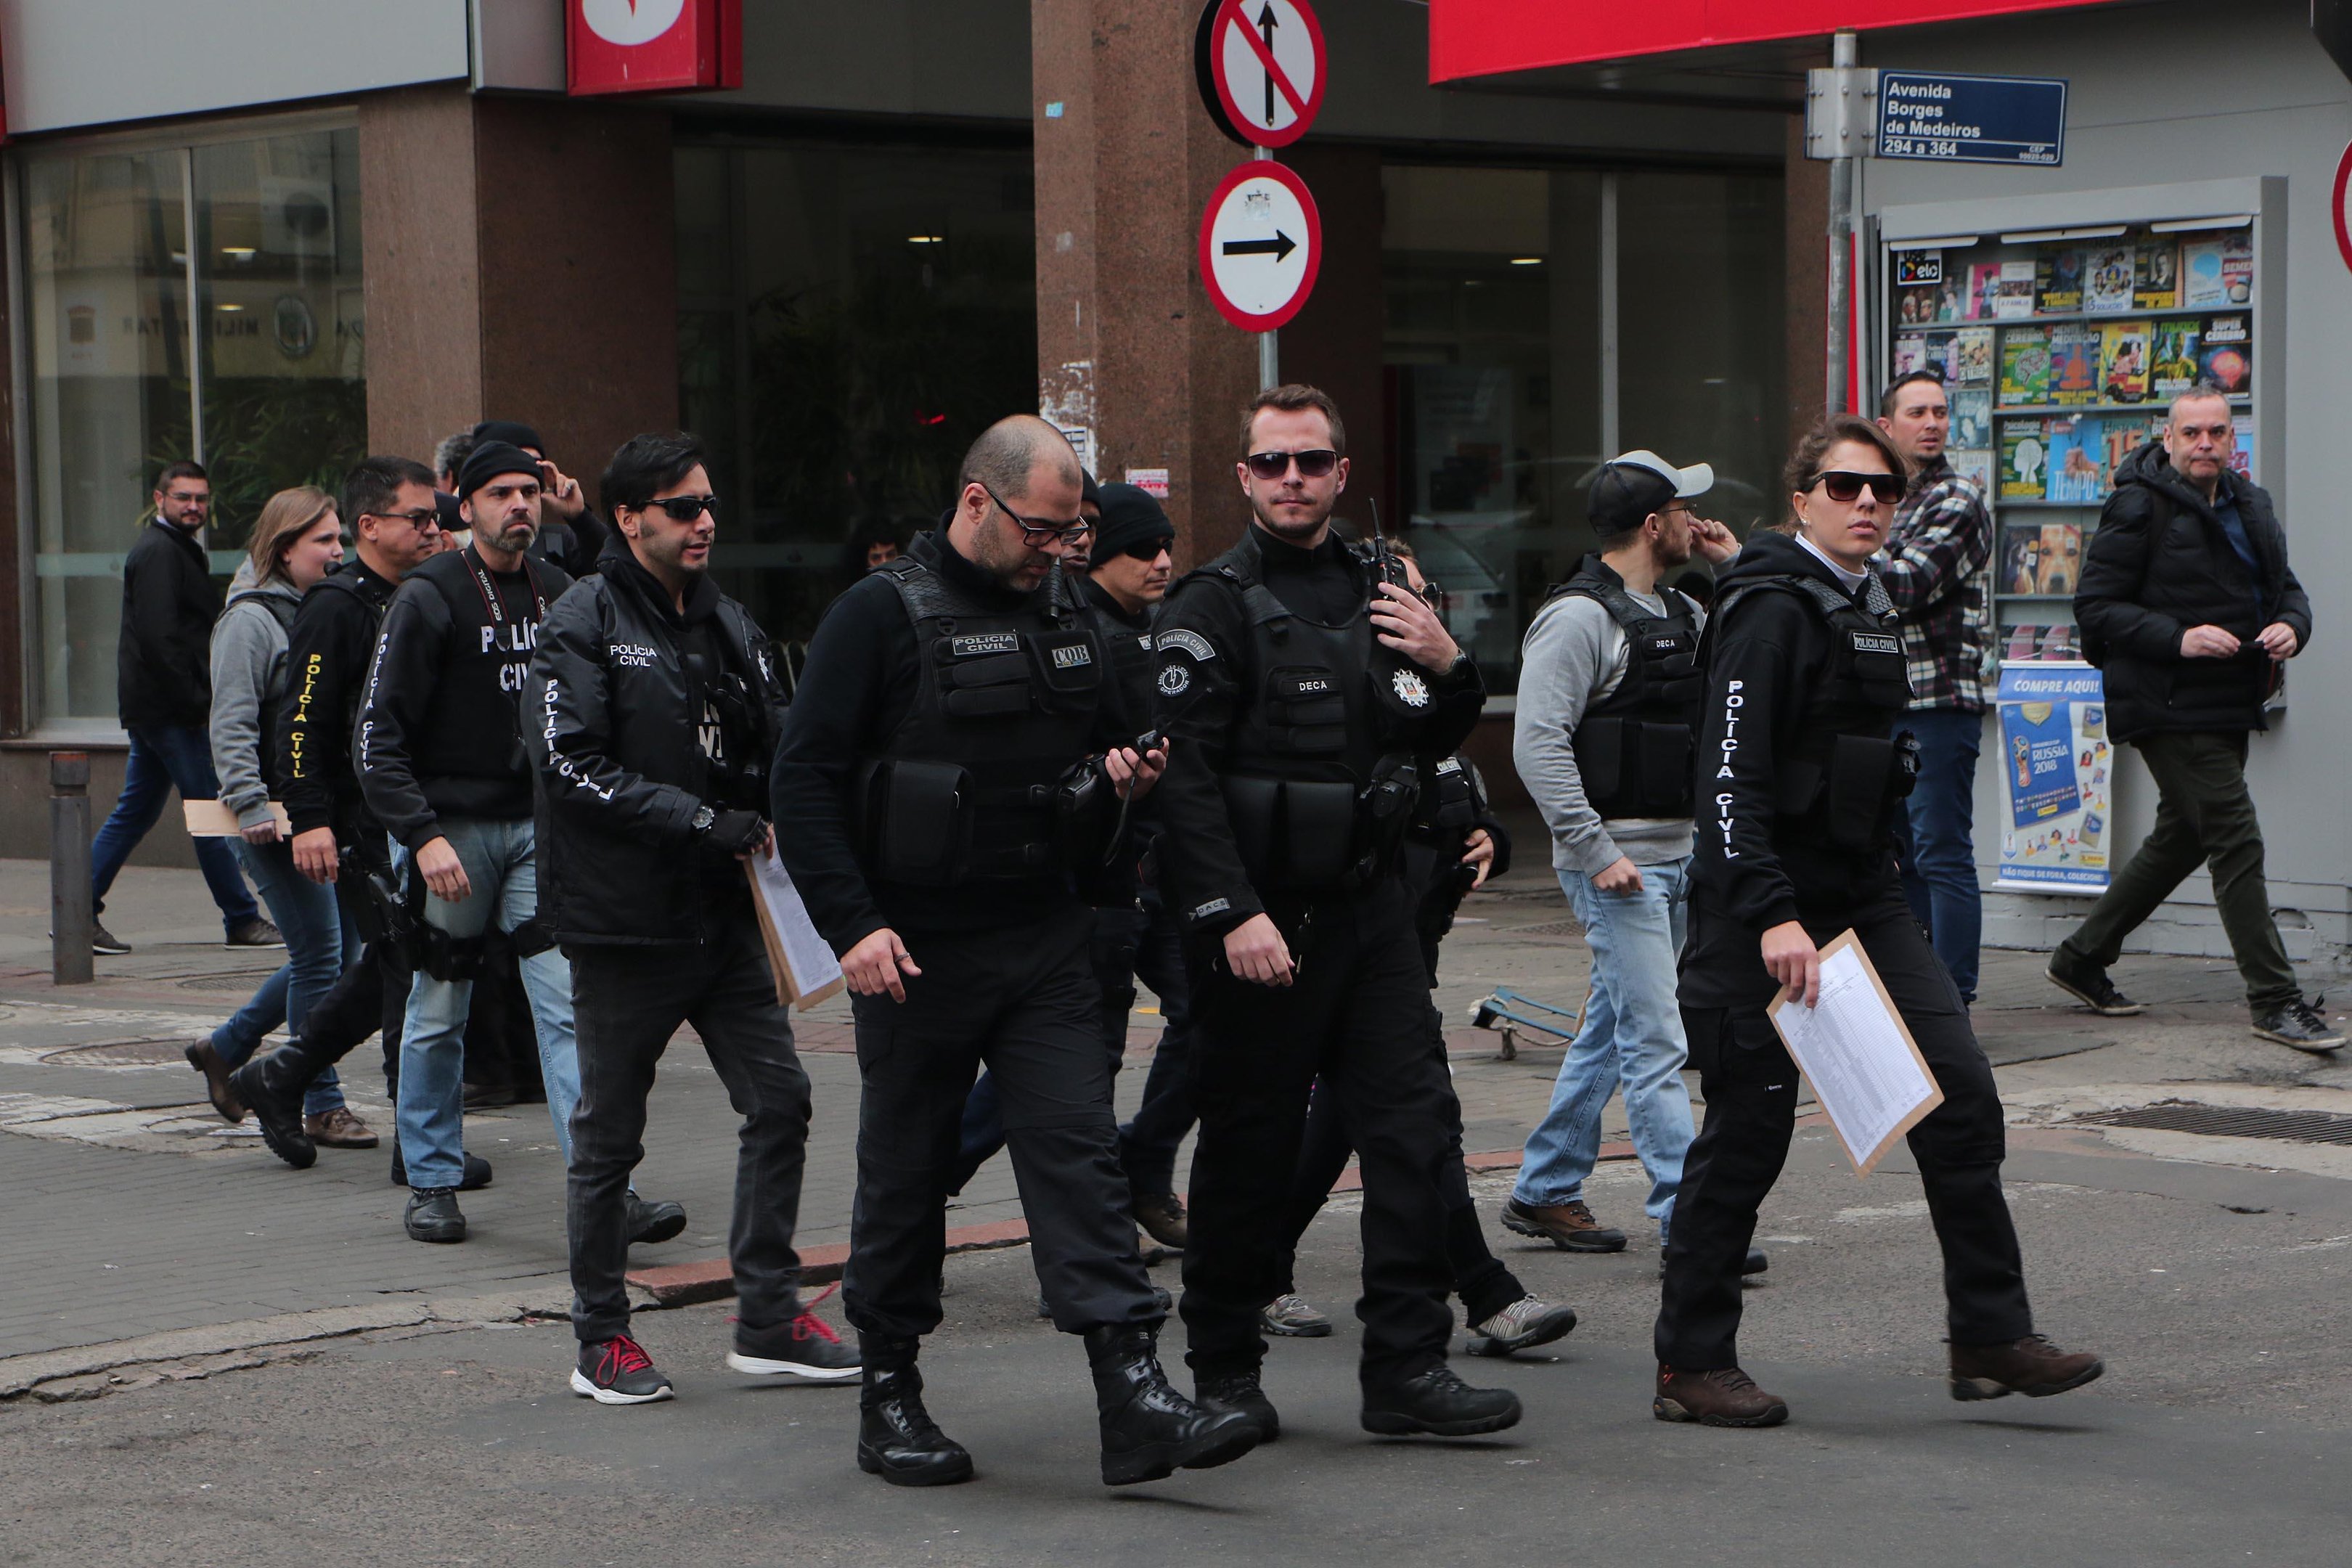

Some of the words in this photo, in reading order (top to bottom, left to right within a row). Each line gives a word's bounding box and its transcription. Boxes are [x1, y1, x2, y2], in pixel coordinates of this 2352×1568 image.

[1888, 81, 1951, 99] Avenida
[1887, 99, 1943, 120] Borges
[1886, 119, 1906, 134] de
[1909, 120, 1981, 138] Medeiros
[1885, 139, 1912, 153] 294
[1916, 143, 1925, 154] a
[1930, 141, 1958, 155] 364
[1916, 262, 1938, 279] elo
[2054, 470, 2094, 500] TEMPO
[491, 603, 502, 621] EOS
[955, 634, 1014, 646] POLÍCIA
[967, 643, 1008, 652] CIVIL
[1190, 639, 1206, 656] CIVIL
[1657, 639, 1675, 648] DECA
[1855, 636, 1879, 648] POLÍCIA
[1879, 639, 1897, 650] CIVIL
[610, 643, 657, 658] POLÍCIA
[619, 655, 650, 667] CIVIL
[293, 654, 322, 723] POLÍCIA
[1160, 679, 1190, 695] OPERADOR
[1299, 680, 1328, 692] DECA
[2014, 680, 2064, 693] COMPRE
[2064, 680, 2099, 695] AQUI!
[544, 678, 564, 765] POLÍCIA
[1716, 679, 1744, 778] POLÍCIA
[360, 721, 374, 772] CIVIL
[2033, 745, 2069, 761] RUSSIA
[291, 732, 306, 779] CIVIL
[2034, 759, 2057, 775] 2018
[559, 761, 614, 801] CIVIL
[1715, 793, 1739, 859] CIVIL
